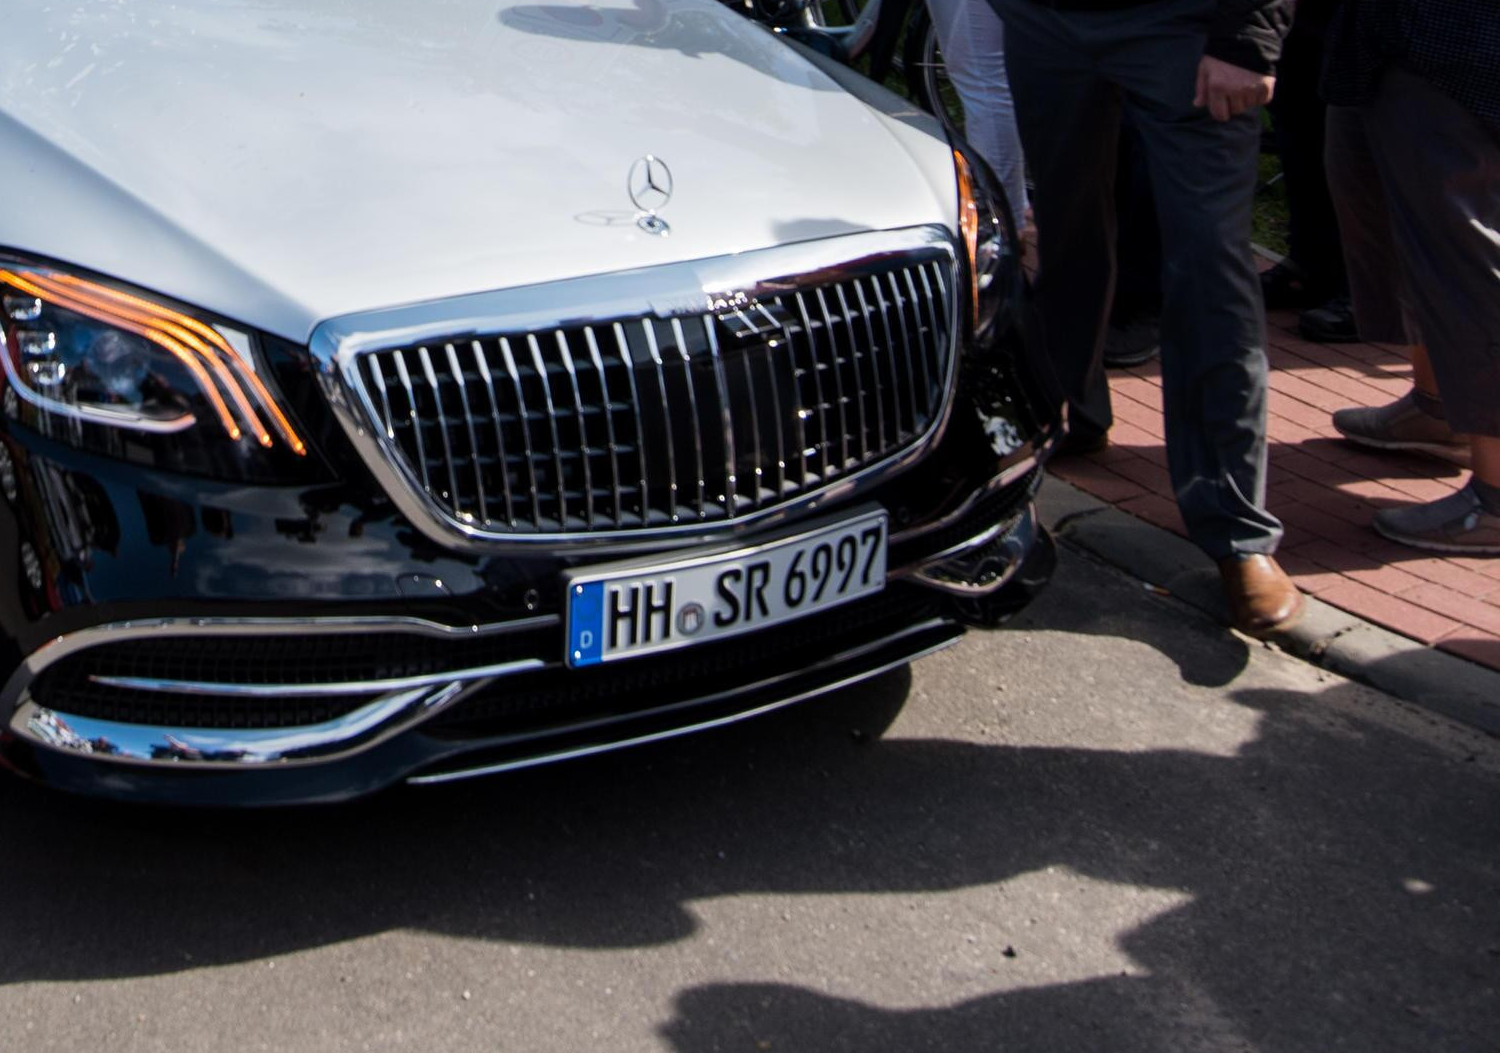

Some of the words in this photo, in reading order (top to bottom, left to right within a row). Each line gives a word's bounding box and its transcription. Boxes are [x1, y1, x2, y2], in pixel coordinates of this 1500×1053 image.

[609, 580, 674, 649] HH
[714, 560, 771, 629] SR
[784, 525, 883, 608] 6997
[580, 630, 594, 649] D
